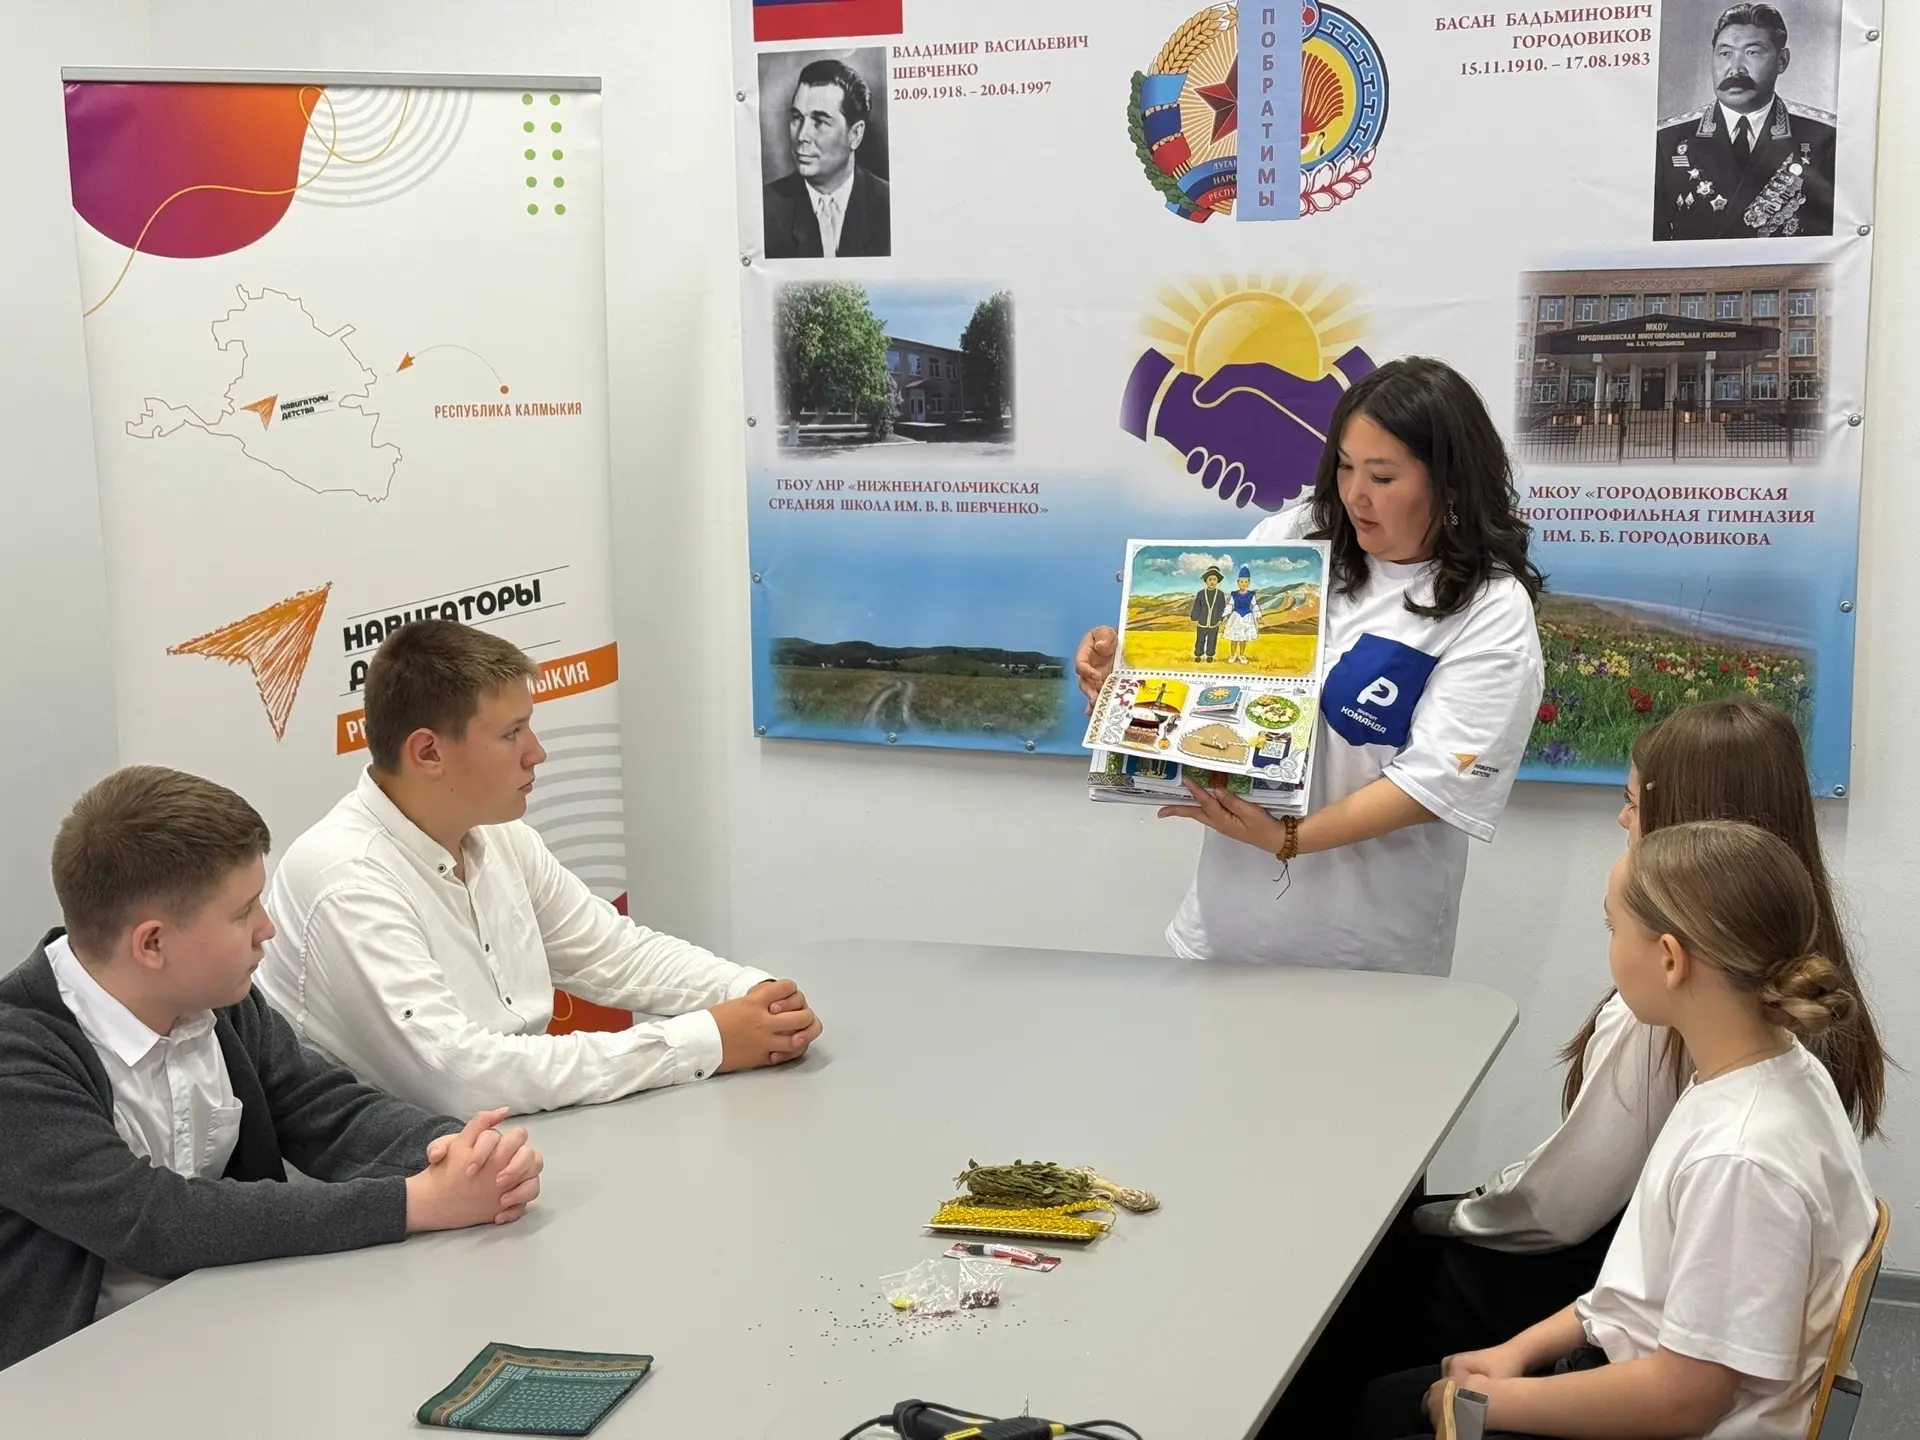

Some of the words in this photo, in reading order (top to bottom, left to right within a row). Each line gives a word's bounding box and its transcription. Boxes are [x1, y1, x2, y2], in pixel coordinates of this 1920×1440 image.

[1435, 14, 1496, 31] БАСАН
[1505, 4, 1653, 28] БАДЬМИНОВИЧ
[892, 42, 979, 60] ВЛАДИМИР
[985, 35, 1089, 54] ВАСИЛЬЕВИЧ
[1512, 28, 1652, 50] ГОРОДОВИКОВ
[892, 63, 979, 80] ШЕВЧЕНКО
[1460, 60, 1548, 76] 15.11.1910.
[1565, 52, 1651, 71] 17.08.1983
[893, 85, 966, 101] 20.09.1918.
[980, 81, 1052, 97] 20.04.1997
[1257, 8, 1276, 207] ПОБРАТИМЫ
[1645, 323, 1668, 331] МКОУ
[280, 394, 329, 411] НАВИГАТОРЫ
[434, 402, 512, 419] РЕСПУБЛИКА
[515, 401, 583, 418] КАЛМЫКИЯ
[282, 406, 315, 421] ДЕТСТВА
[777, 479, 814, 491] ГБОУ
[816, 479, 844, 492] ЛНР
[848, 479, 1040, 495] «НИЖНЕНАГОЛЬЧИКСКАЯ
[1528, 485, 1582, 499] МКОУ
[1585, 486, 1789, 502] «ГОРОДОВИКОВСКАЯ
[769, 498, 835, 512] СРЕДНЯЯ
[840, 499, 892, 512] ШКОЛА
[894, 499, 923, 513] ИМ.
[925, 500, 938, 513] В.
[941, 501, 953, 513] В.
[955, 501, 1049, 515] ШЕВЧЕНКО»
[1512, 507, 1700, 523] НОГОПРОФИЛЬНАЯ
[1707, 509, 1816, 524] ГИМНАЗИЯ
[1542, 529, 1576, 543] ИМ.
[1580, 530, 1595, 543] Б.
[1599, 530, 1615, 543] Б.
[1618, 531, 1772, 547] ГОРОДОВИКОВА
[1340, 705, 1388, 734] КОМАНДА
